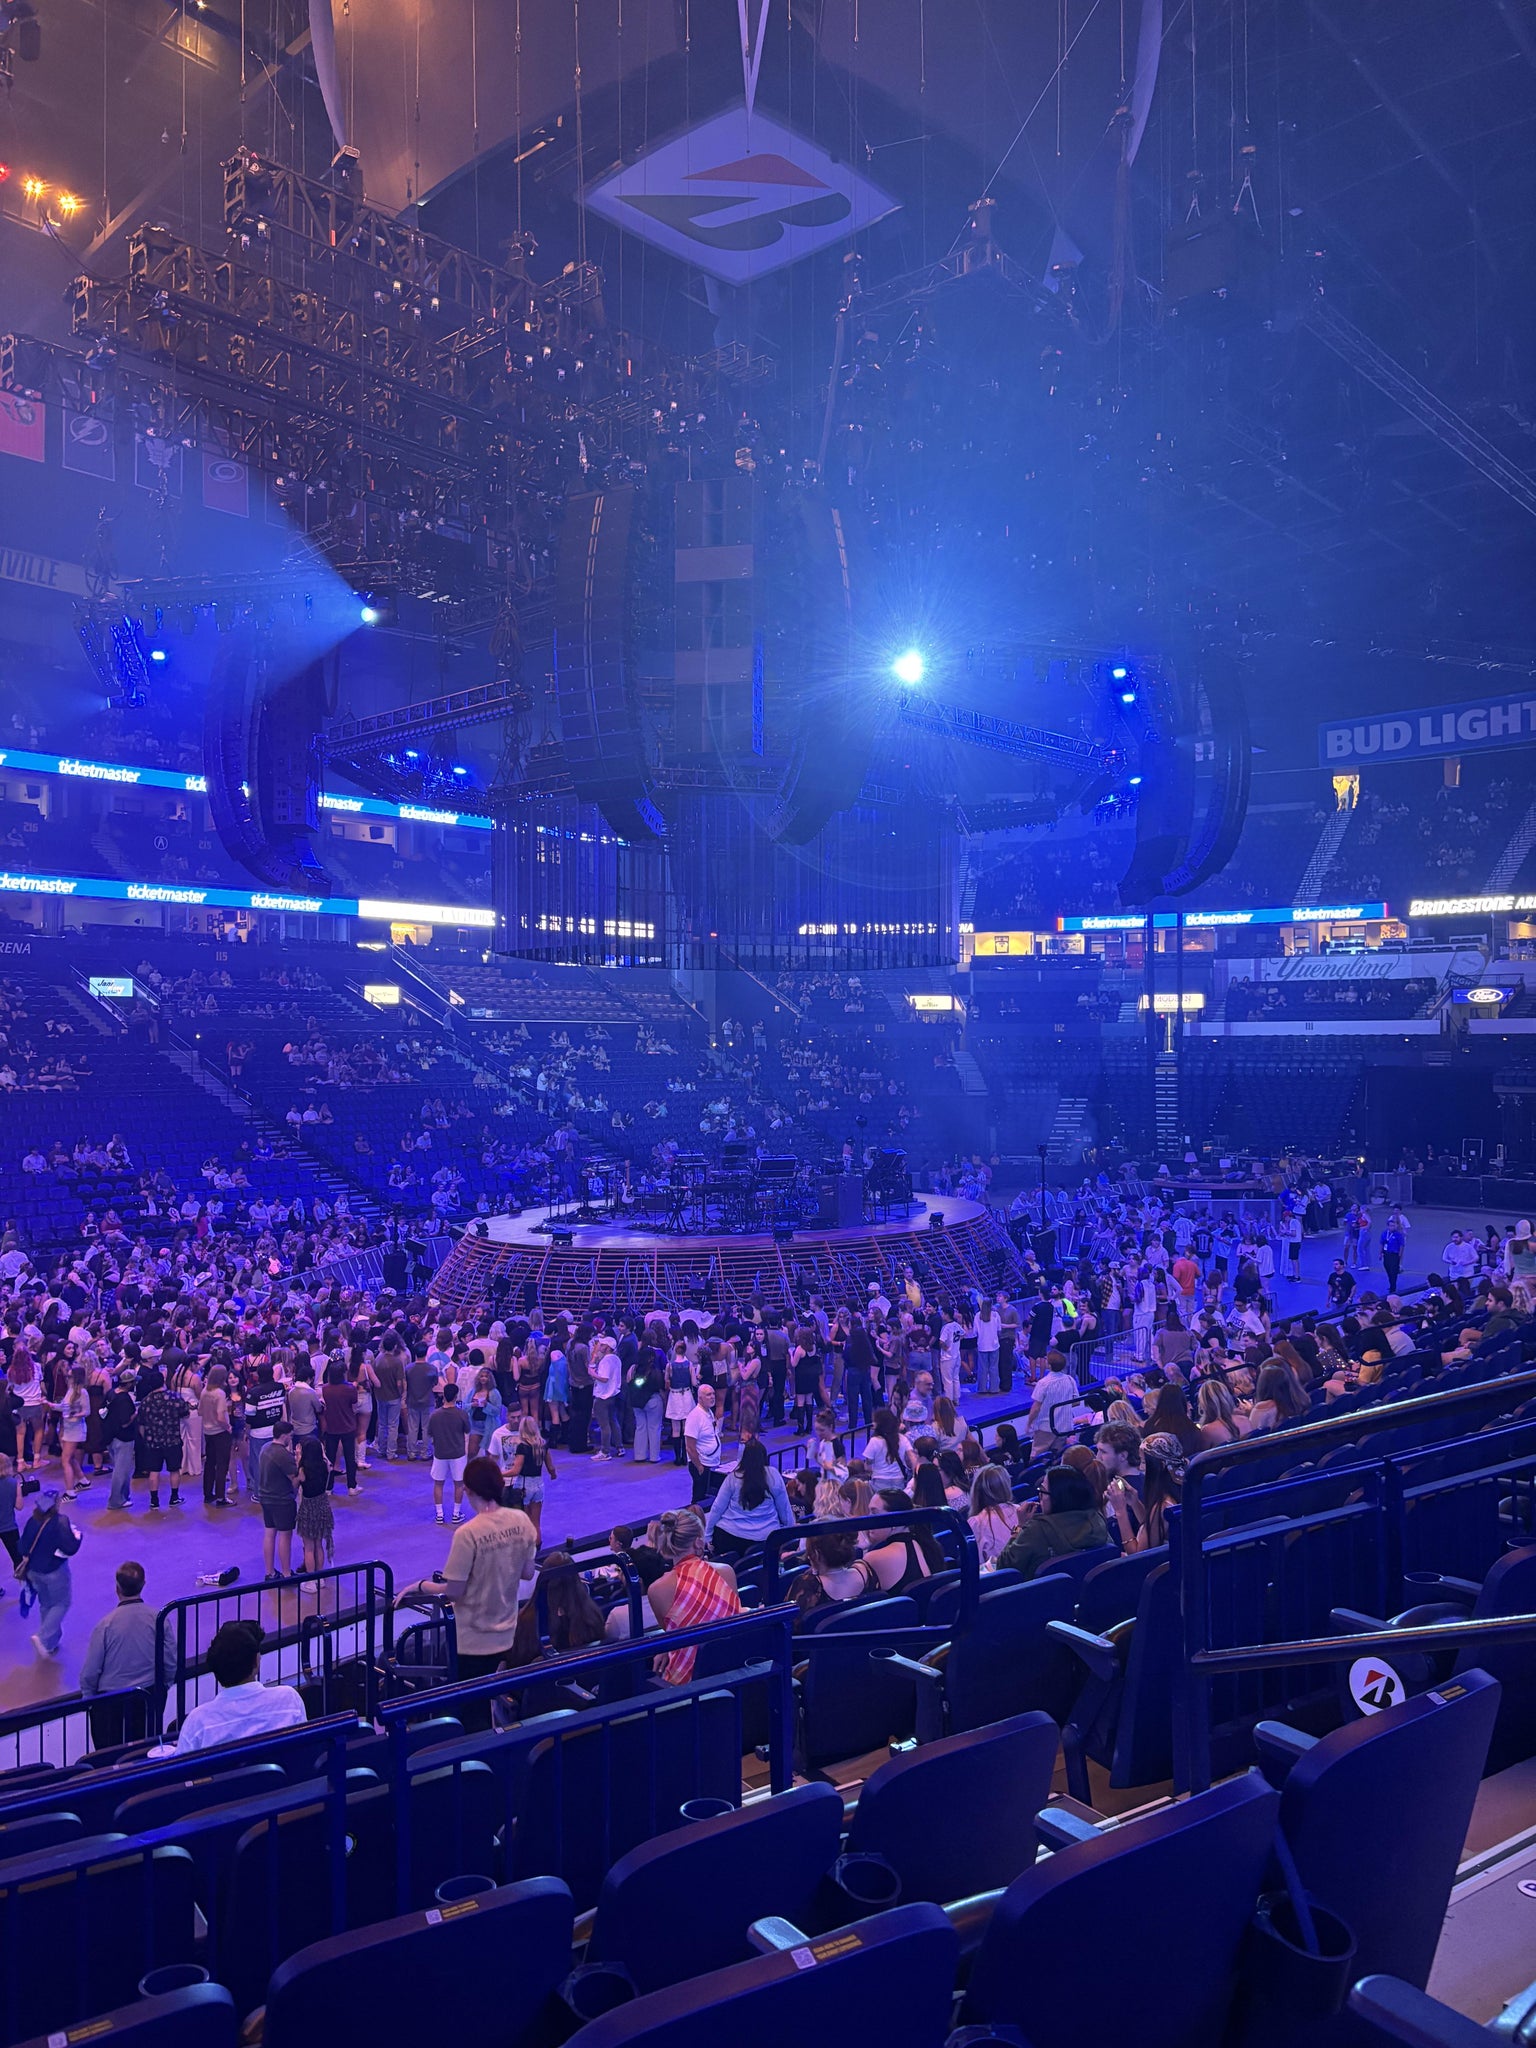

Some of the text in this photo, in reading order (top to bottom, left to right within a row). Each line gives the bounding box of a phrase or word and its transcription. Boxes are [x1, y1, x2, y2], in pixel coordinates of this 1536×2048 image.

[1327, 700, 1536, 758] BUD LIGHT
[58, 760, 141, 783] ticketmaster
[400, 806, 459, 825] ticketmaster
[127, 884, 207, 903] ticketmaster
[251, 893, 323, 912] ticketmaster
[1292, 907, 1364, 921] ticketmaster
[1409, 896, 1536, 916] BRIDGESTONE AR
[1082, 917, 1146, 929] ticketmaster
[1186, 912, 1254, 926] ticketmaster
[215, 951, 228, 961] 115
[1277, 956, 1400, 981] Yuengling
